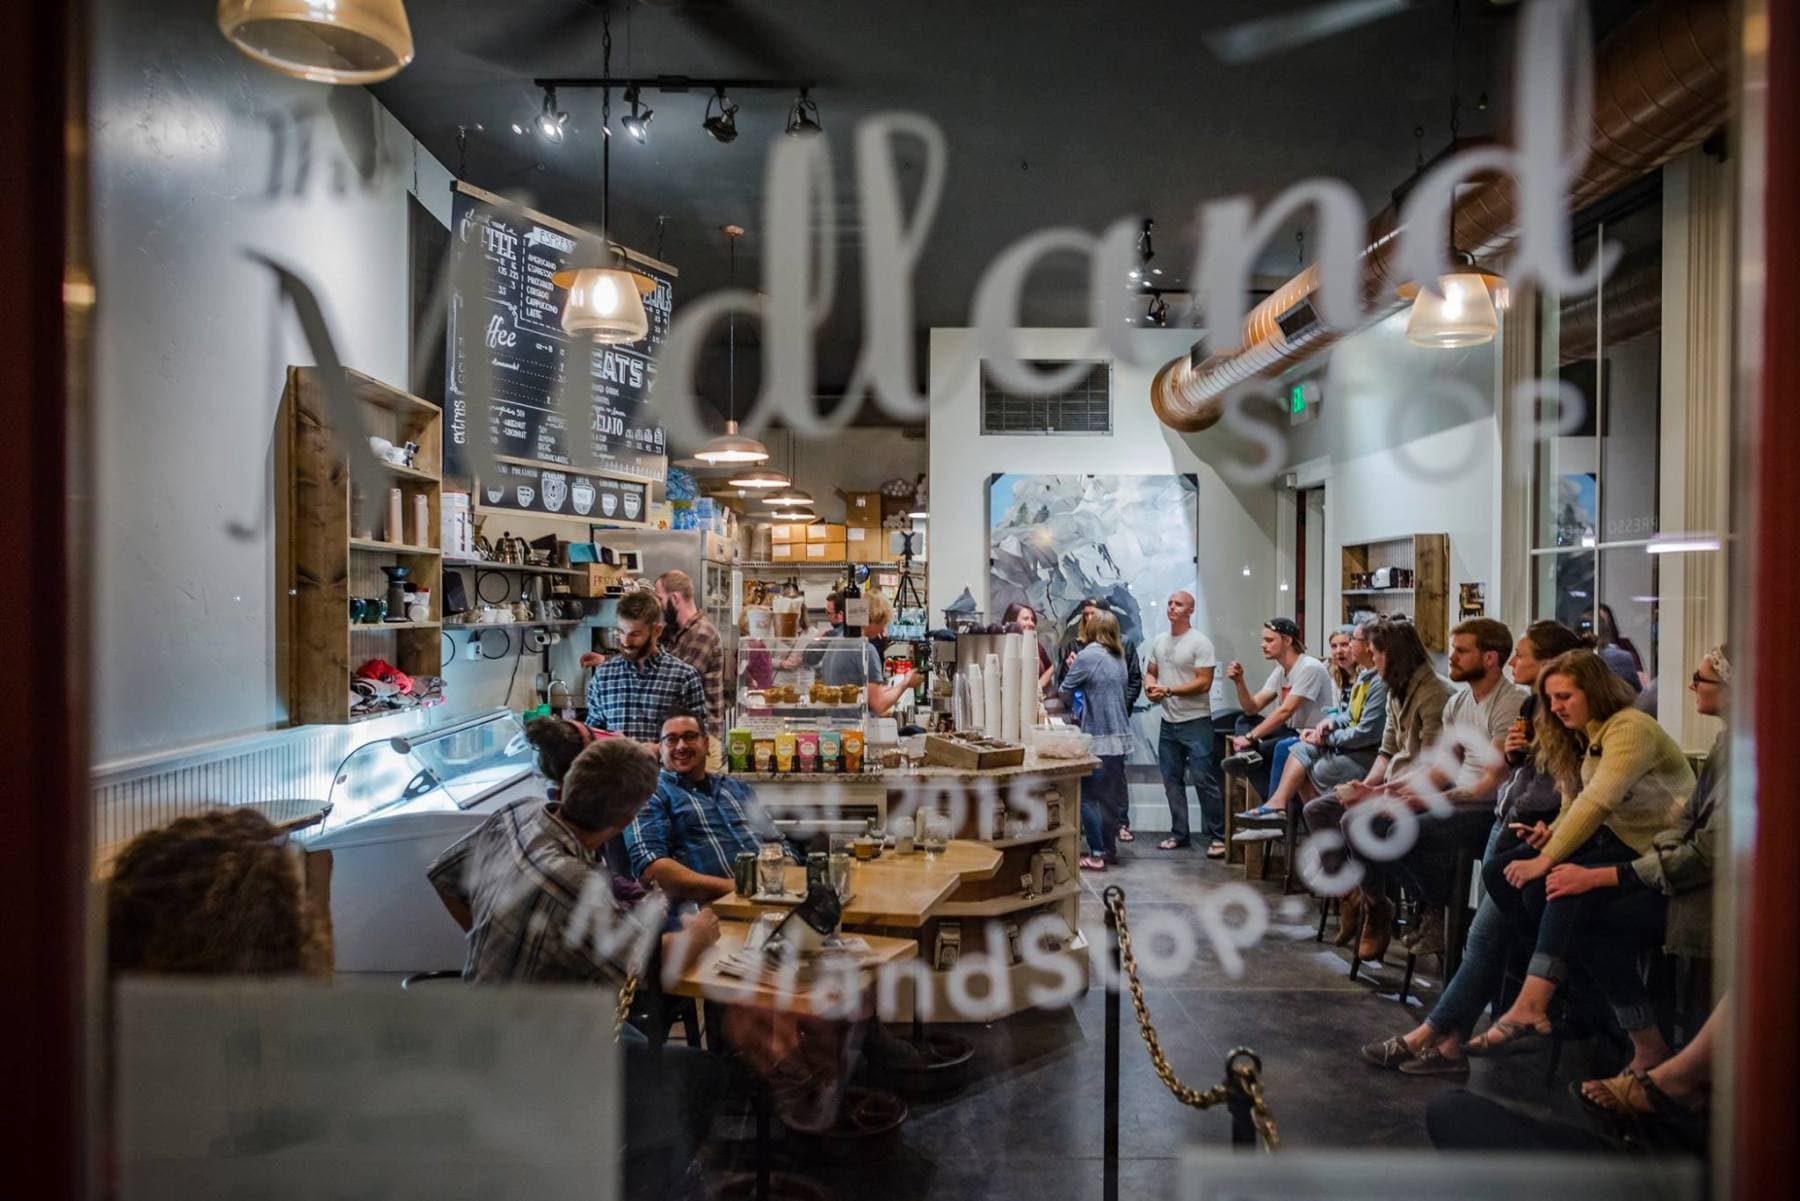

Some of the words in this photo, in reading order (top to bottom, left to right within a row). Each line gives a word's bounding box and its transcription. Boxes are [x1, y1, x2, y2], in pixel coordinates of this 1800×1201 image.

[460, 218, 518, 260] CFFEE
[485, 314, 517, 349] ffee
[591, 347, 645, 389] EATS
[1217, 375, 1587, 487] SOP
[886, 776, 1051, 845] 2015
